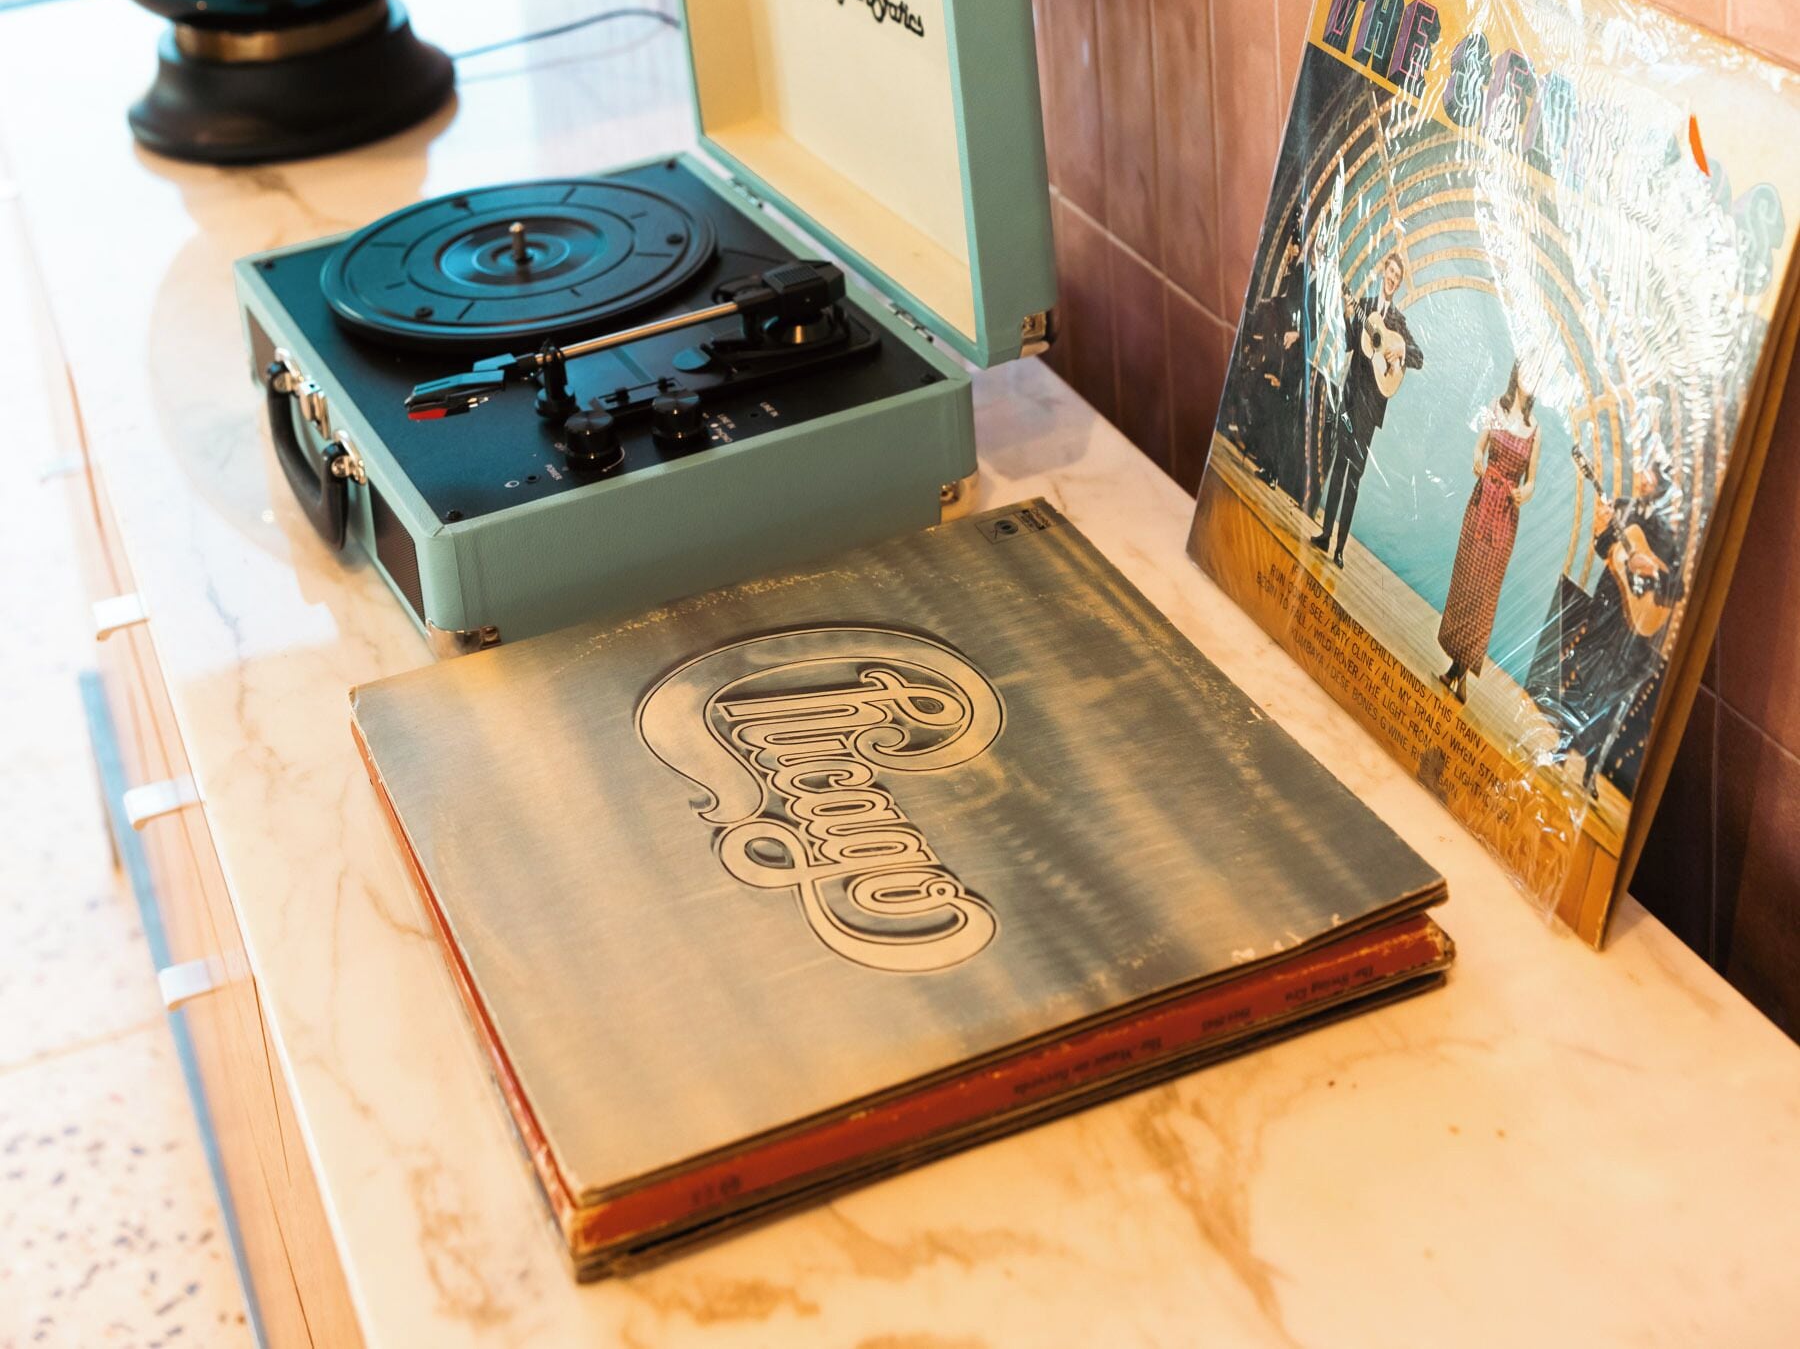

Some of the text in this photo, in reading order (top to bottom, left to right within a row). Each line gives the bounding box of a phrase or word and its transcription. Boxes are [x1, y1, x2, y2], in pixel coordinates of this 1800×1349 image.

[1270, 564, 1286, 586] RUN
[1309, 602, 1324, 624] SEE
[1331, 622, 1350, 646] KATY
[1352, 643, 1374, 671] CLINE
[1381, 672, 1395, 693] ALL
[1397, 687, 1412, 706] MY
[1414, 701, 1441, 736] TRIALS
[1450, 736, 1476, 767] WHEN
[1280, 593, 1288, 610] TO
[1313, 629, 1331, 651] WILD
[1334, 647, 1359, 679] ROVER
[1365, 676, 1381, 699] THE
[1382, 694, 1407, 725] LIGHT
[1408, 720, 1431, 749] FROM
[1307, 576, 1321, 598] HAD
[1323, 595, 1331, 607] A
[1331, 602, 1364, 636] HAMMER
[1370, 640, 1398, 670] CHILLY
[1400, 664, 1425, 698] WINDS
[1434, 696, 1453, 723] THIS
[1455, 717, 1481, 748] TRAIN
[1331, 666, 1350, 692] DESE
[1352, 688, 1378, 720] BONES
[634, 621, 1008, 973] Chicago
